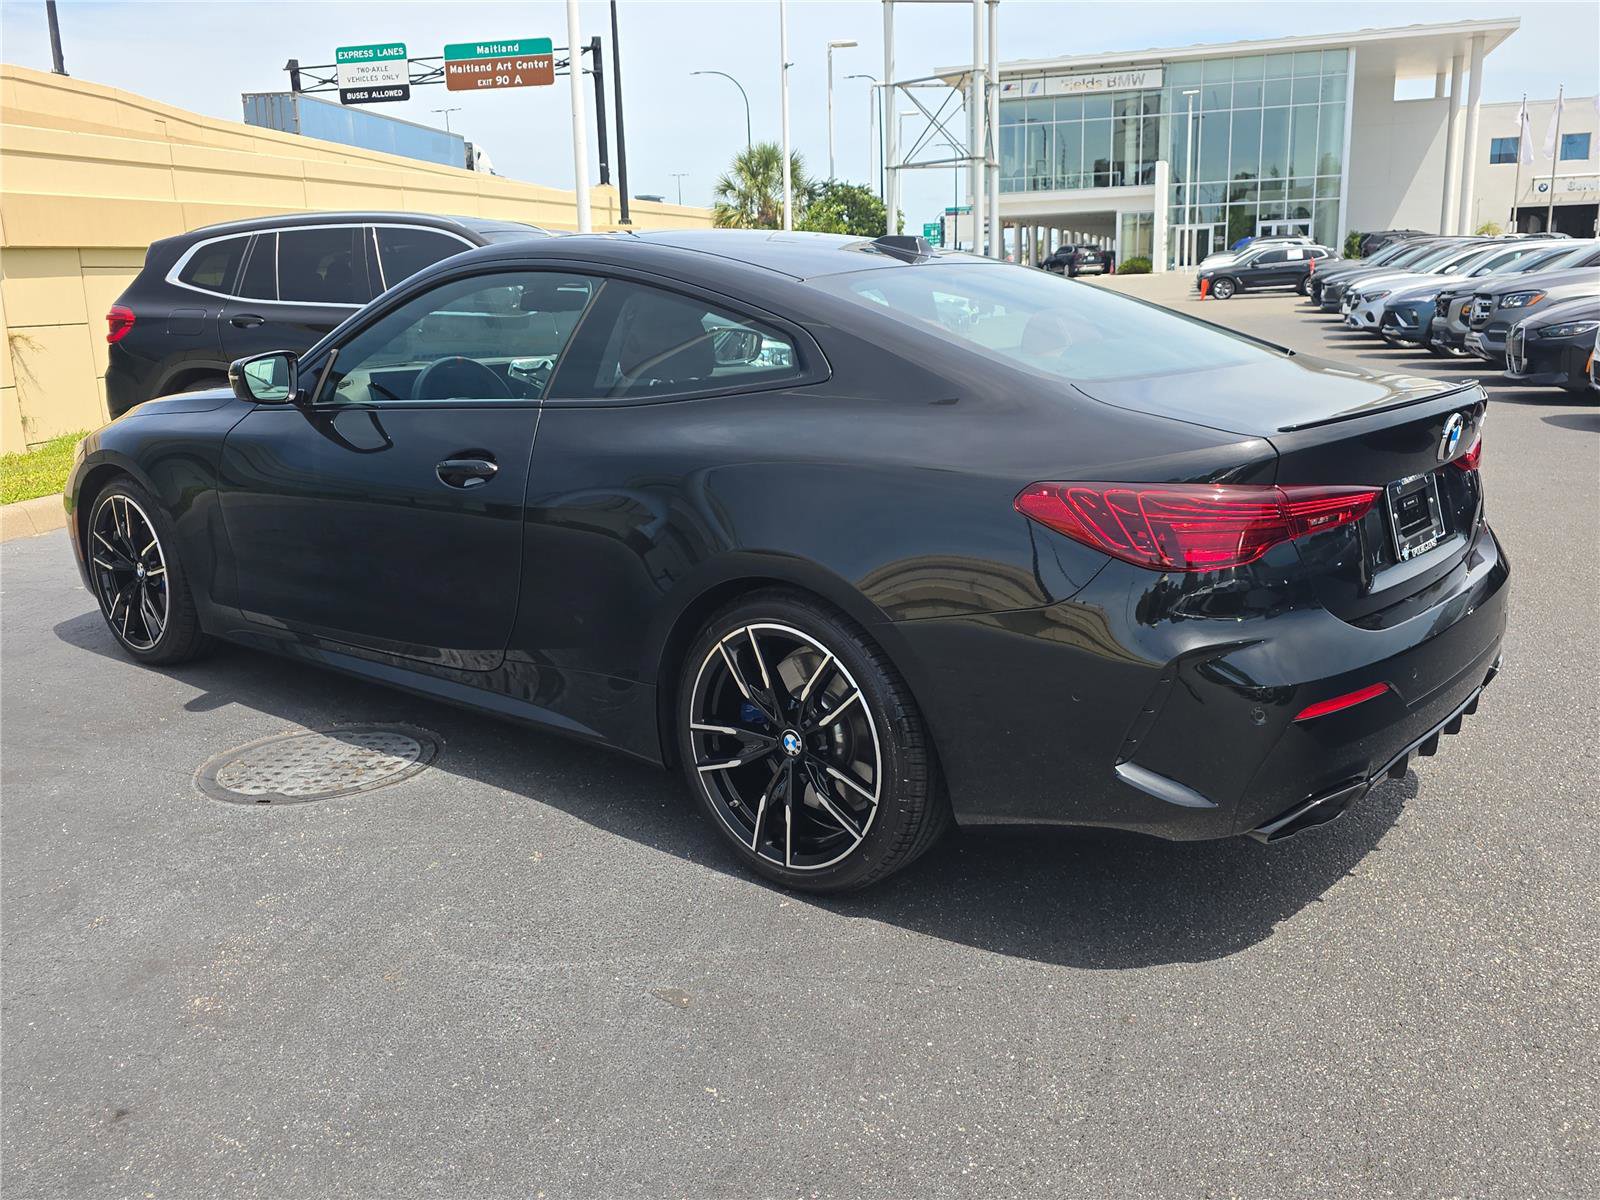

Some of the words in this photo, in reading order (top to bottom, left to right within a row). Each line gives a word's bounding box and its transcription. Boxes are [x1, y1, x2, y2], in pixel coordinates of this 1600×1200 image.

[338, 50, 374, 60] EXPRESS
[377, 47, 404, 57] LANES
[476, 43, 520, 55] Maitland
[357, 65, 389, 74] TWO-AXLE
[449, 63, 492, 74] Maitland
[496, 62, 512, 71] Art
[516, 60, 549, 69] Center
[346, 75, 379, 83] VEHICLES
[381, 73, 400, 81] ONLY
[477, 79, 493, 87] EXIT
[495, 75, 509, 85] 90
[514, 74, 523, 84] A
[1060, 77, 1103, 91] elds
[1106, 72, 1146, 88] BMW
[346, 91, 369, 100] BUSES
[372, 89, 404, 98] ALLOWED
